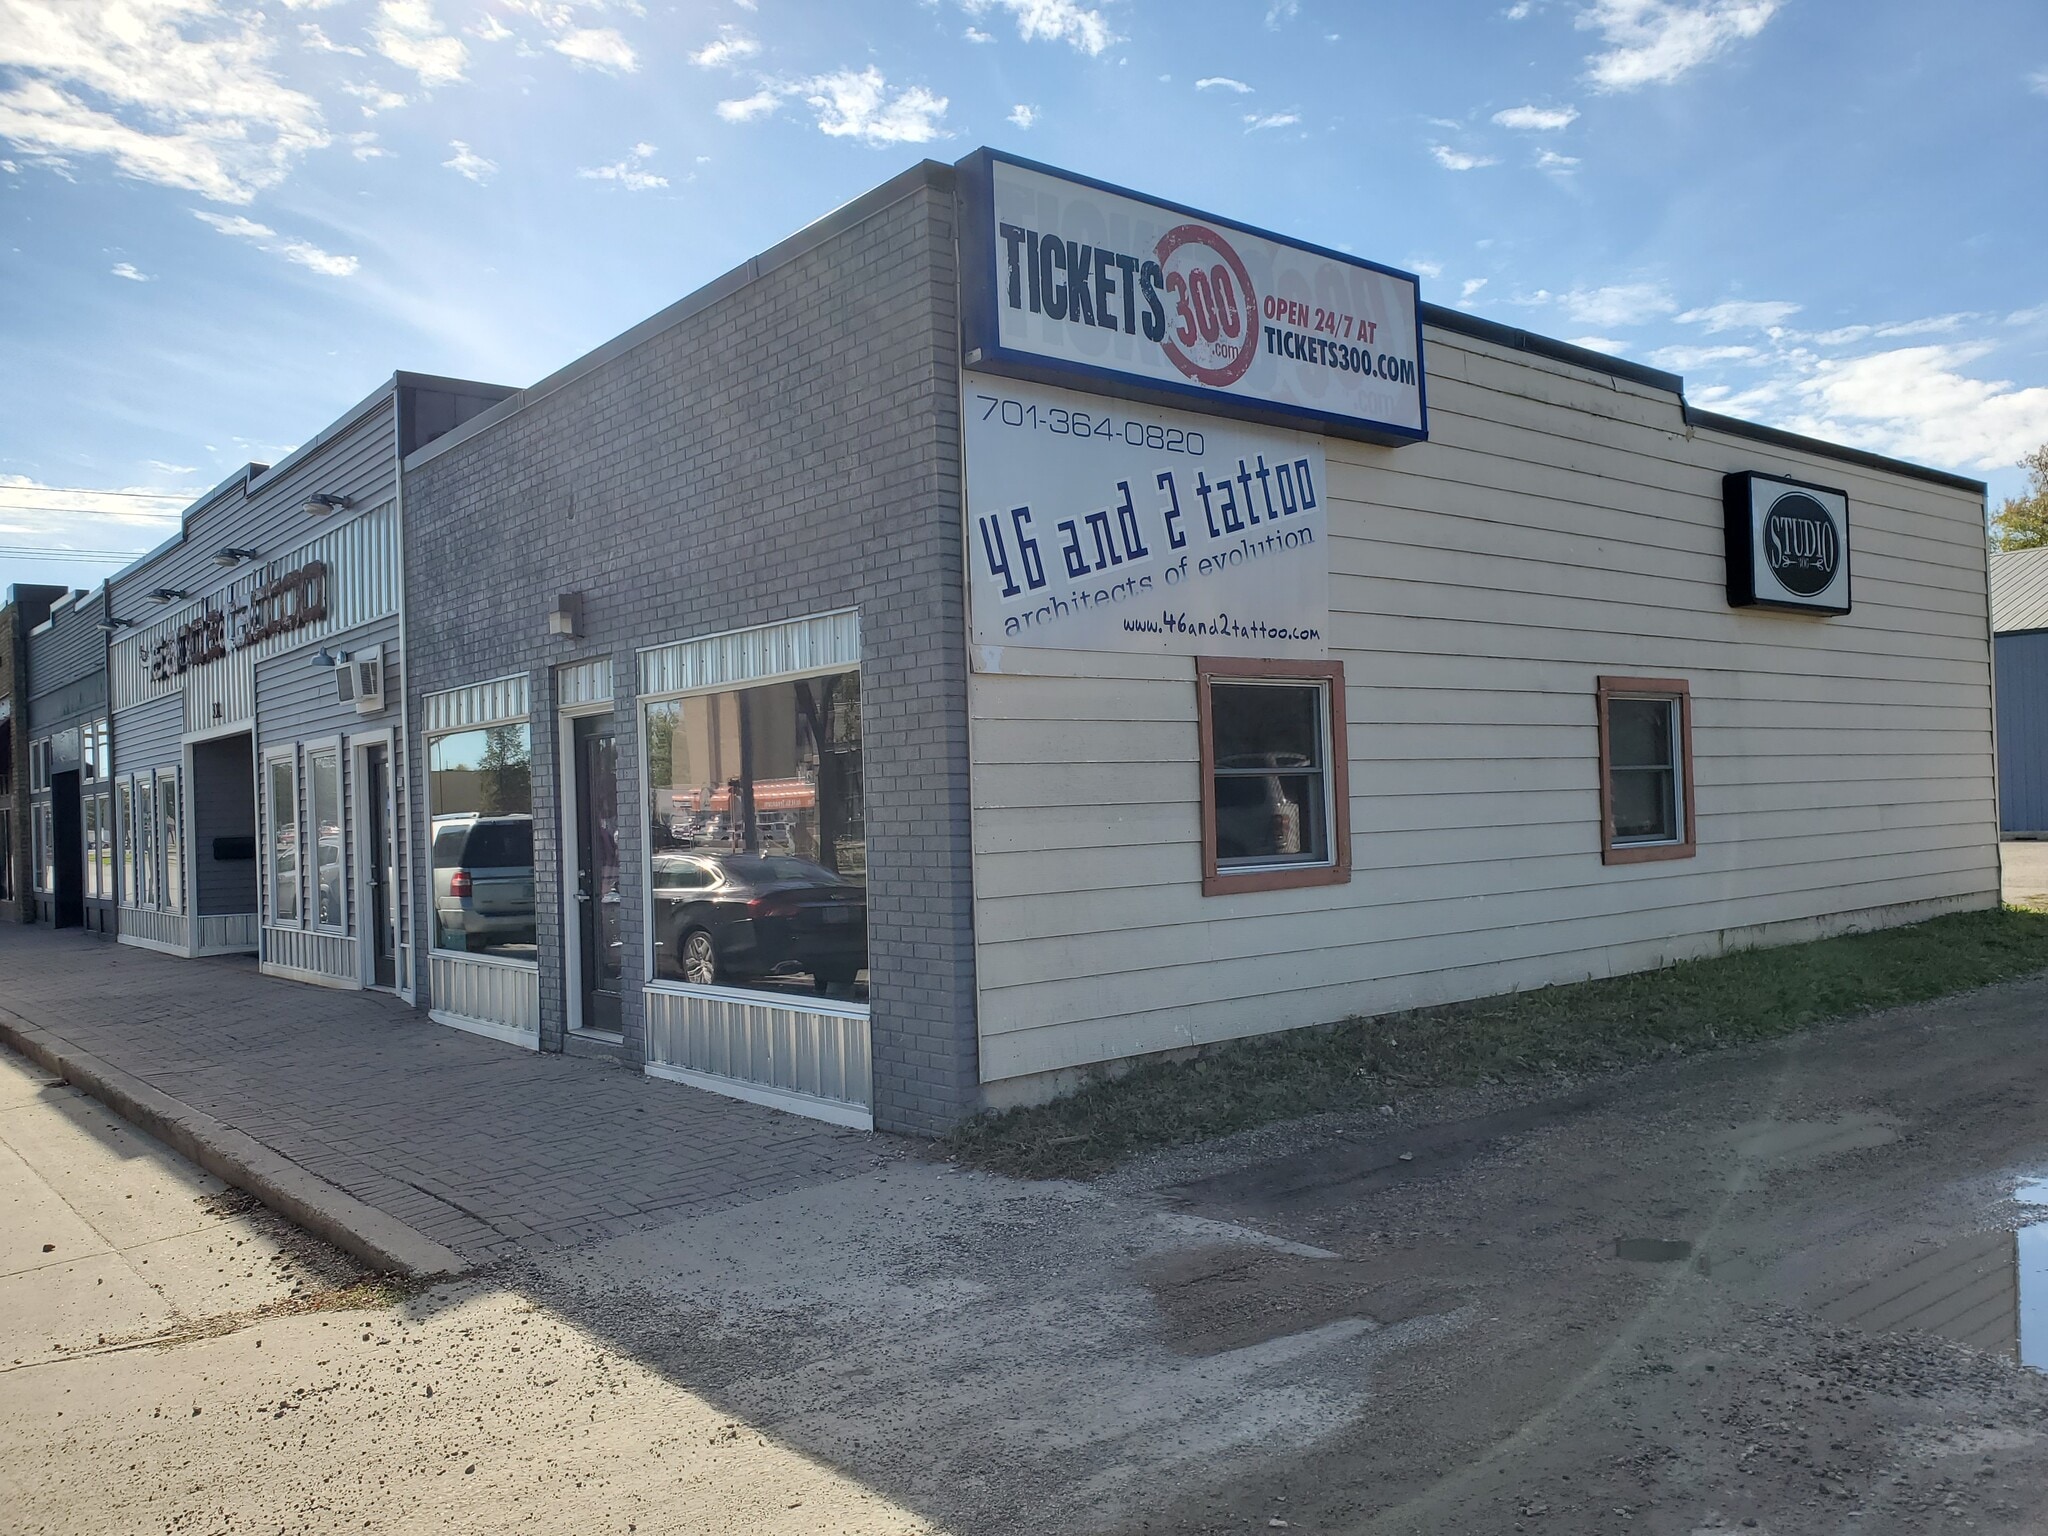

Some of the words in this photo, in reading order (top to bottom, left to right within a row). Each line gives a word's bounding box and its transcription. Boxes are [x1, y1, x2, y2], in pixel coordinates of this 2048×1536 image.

[999, 222, 1166, 343] TICKETS
[1166, 264, 1241, 347] 300
[1263, 295, 1310, 328] OPEN
[1314, 308, 1354, 338] 24/7
[1357, 320, 1377, 344] AT
[1264, 326, 1416, 386] TICKETS300.COM
[977, 395, 1205, 456] 701-364-0820
[979, 505, 1047, 598] 46
[1057, 480, 1149, 579] and
[1156, 471, 1187, 550] 2
[1196, 455, 1317, 539] tattoo
[1770, 515, 1834, 572] STUDIO
[1004, 574, 1153, 637] architects
[1164, 556, 1190, 587] of
[1198, 527, 1316, 577] evolution
